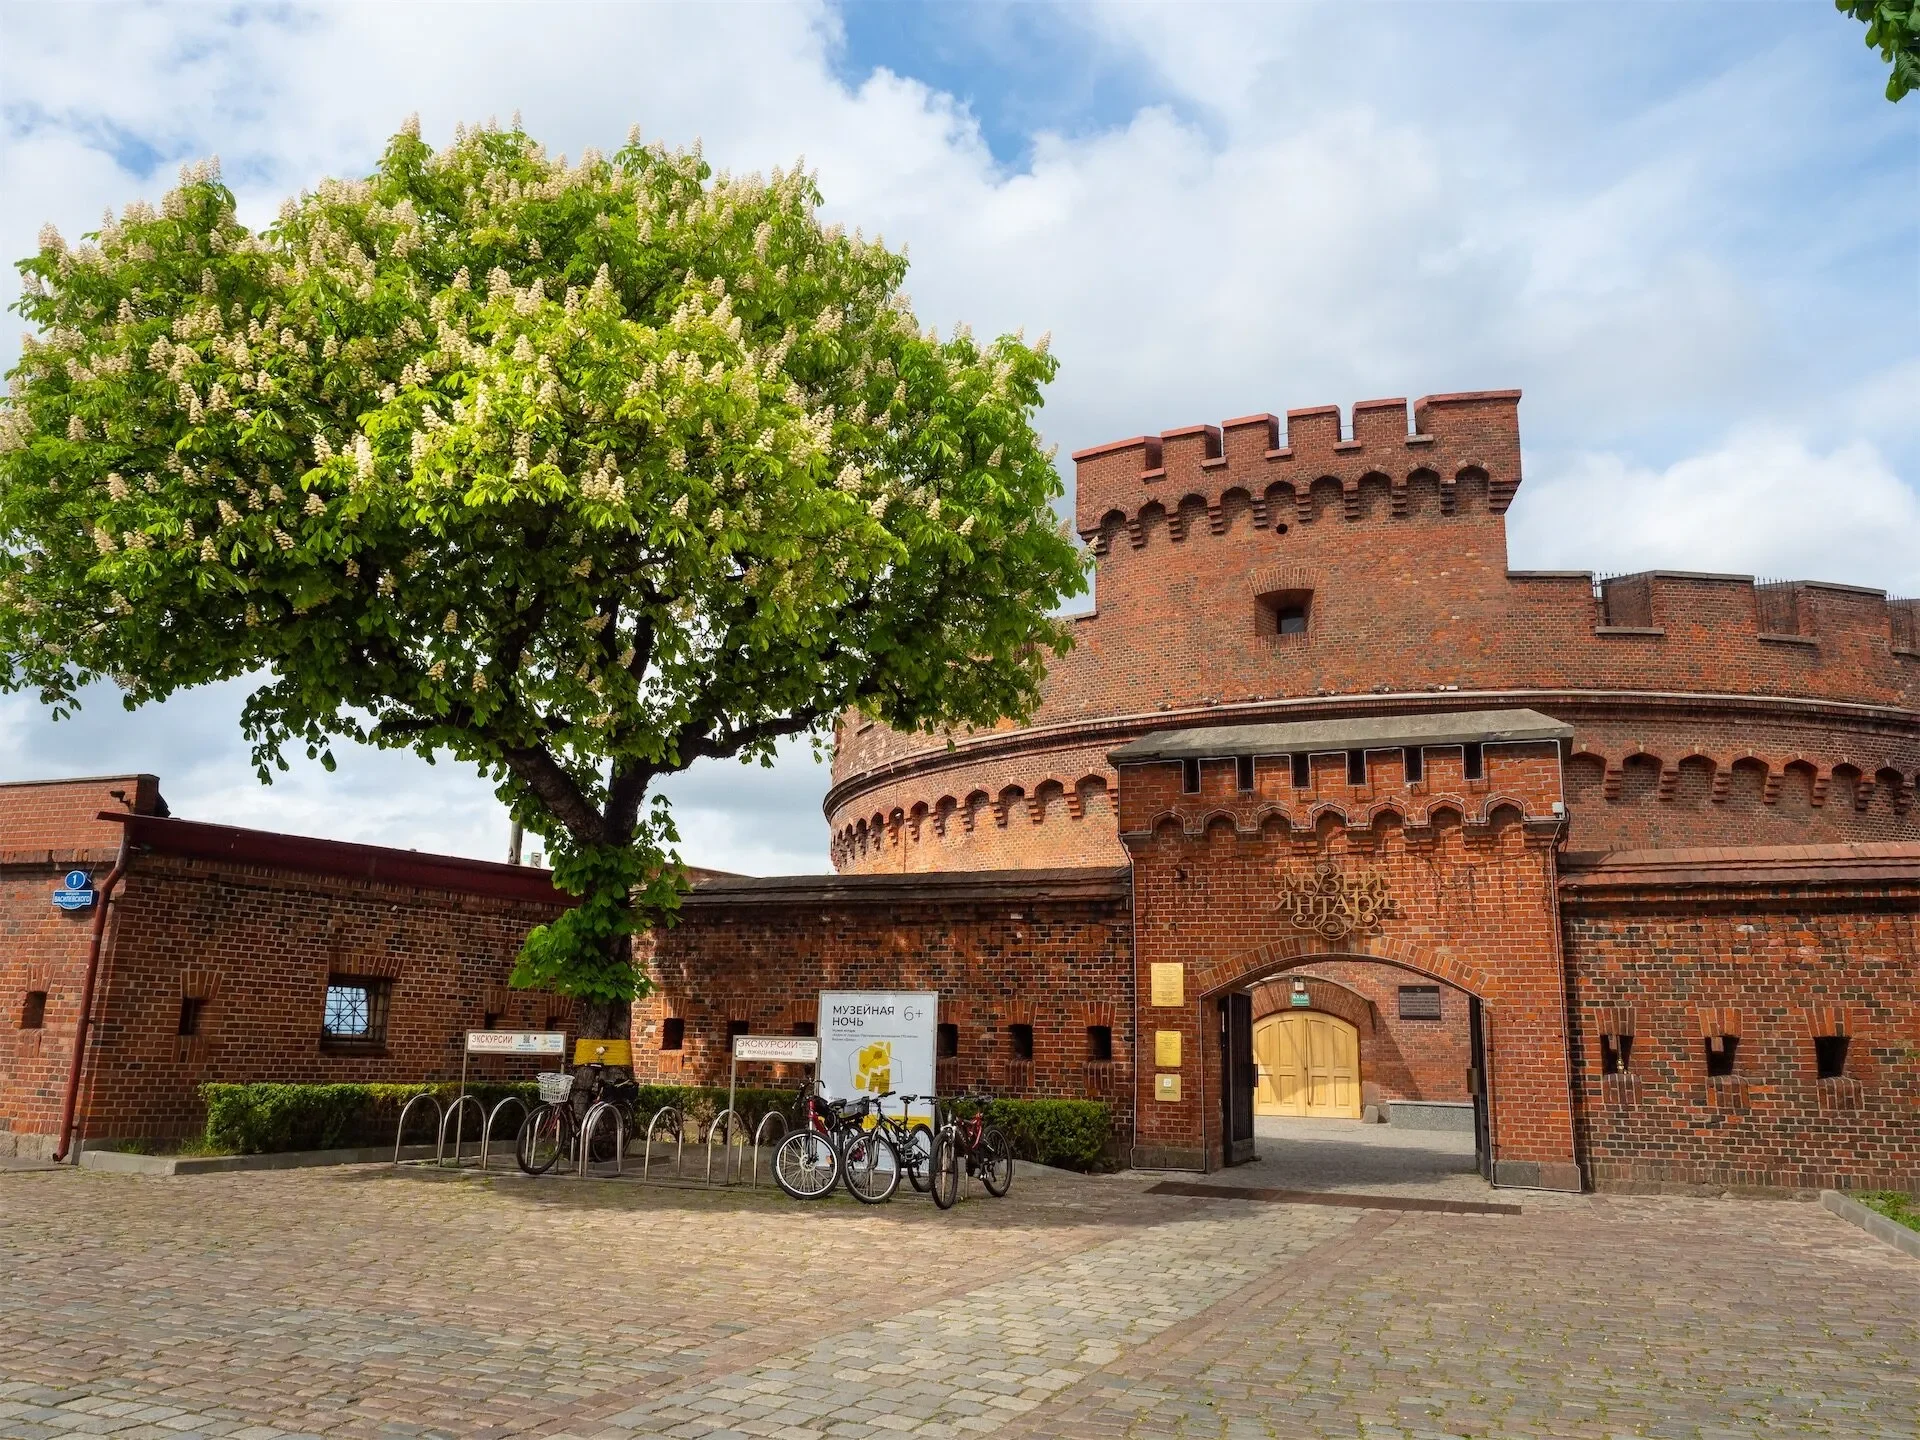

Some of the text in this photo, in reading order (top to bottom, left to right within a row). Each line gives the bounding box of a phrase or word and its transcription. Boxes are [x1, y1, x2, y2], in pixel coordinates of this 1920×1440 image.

[72, 874, 77, 885] 1
[1279, 862, 1385, 896] МУЗЕЙ
[1270, 886, 1400, 934] ЯНТАРЯ
[832, 1003, 895, 1015] МУЗЕЙНАЯ
[903, 1005, 924, 1021] 6+
[832, 1017, 864, 1027] НОЧЬ
[471, 1034, 513, 1044] ЭКСКУРСИИ
[737, 1039, 798, 1049] ЭКСКУРСИИ
